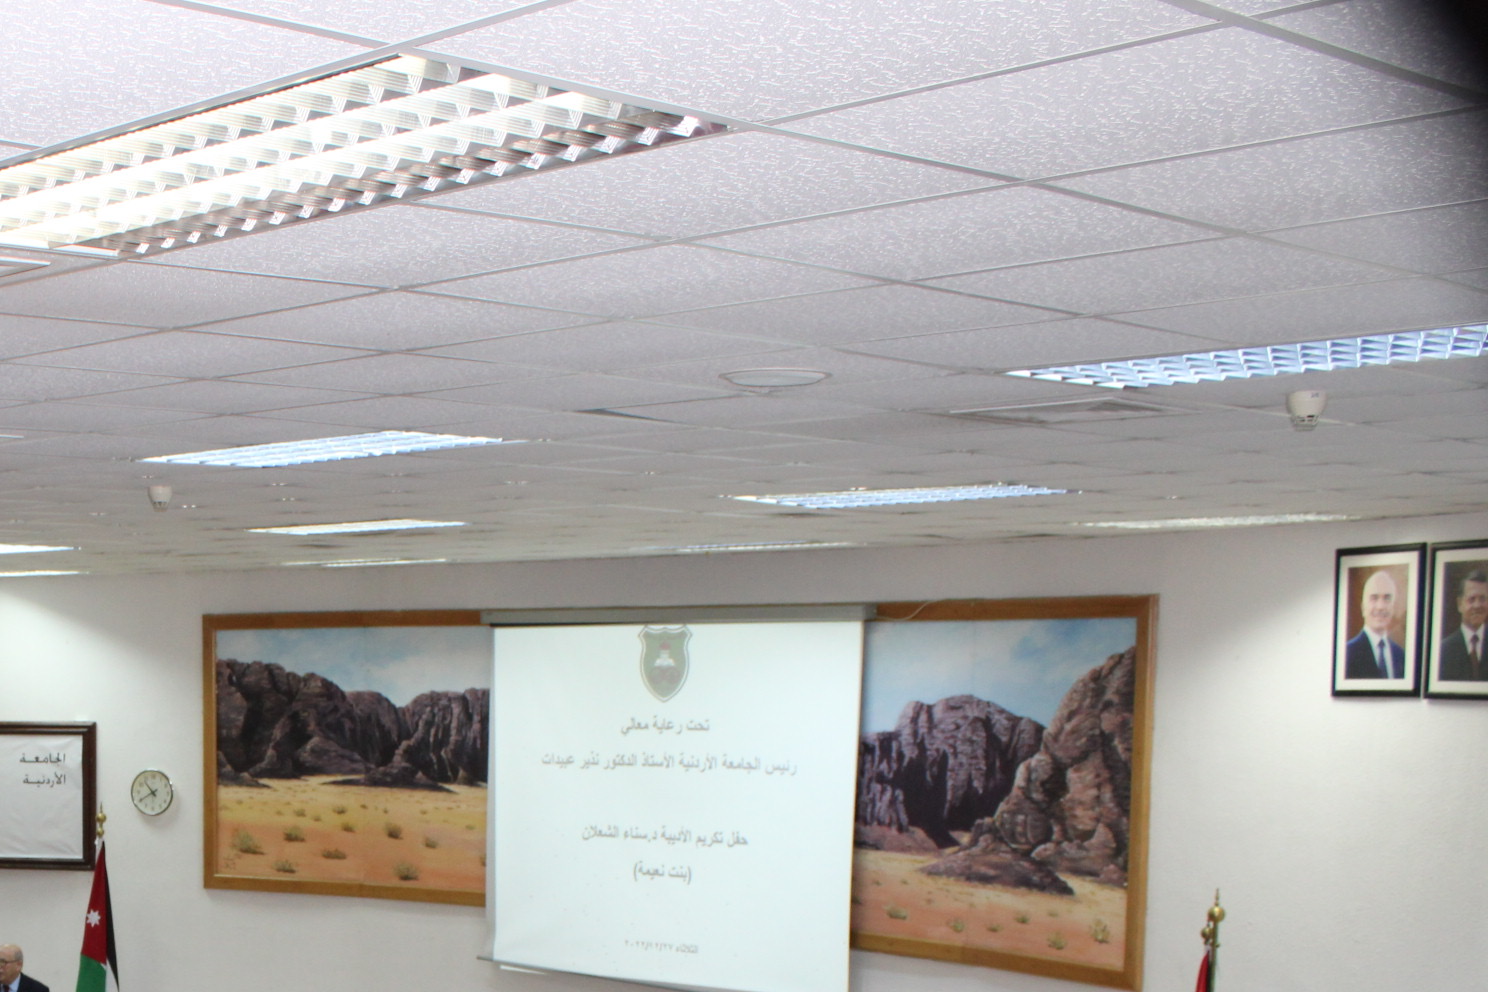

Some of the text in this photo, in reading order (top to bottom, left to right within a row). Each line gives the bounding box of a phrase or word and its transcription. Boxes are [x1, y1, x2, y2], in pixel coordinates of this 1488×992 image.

[620, 714, 710, 737] تحت رعاية معالي
[541, 750, 798, 777] رئيس الجامعة الأردنية الأستاذ الدكتور نذير عبيدات
[581, 823, 620, 841] الشعلان
[660, 825, 692, 846] الأديبة
[695, 831, 724, 848] تكريم
[726, 831, 749, 848] حفل
[668, 864, 693, 885] (بنت
